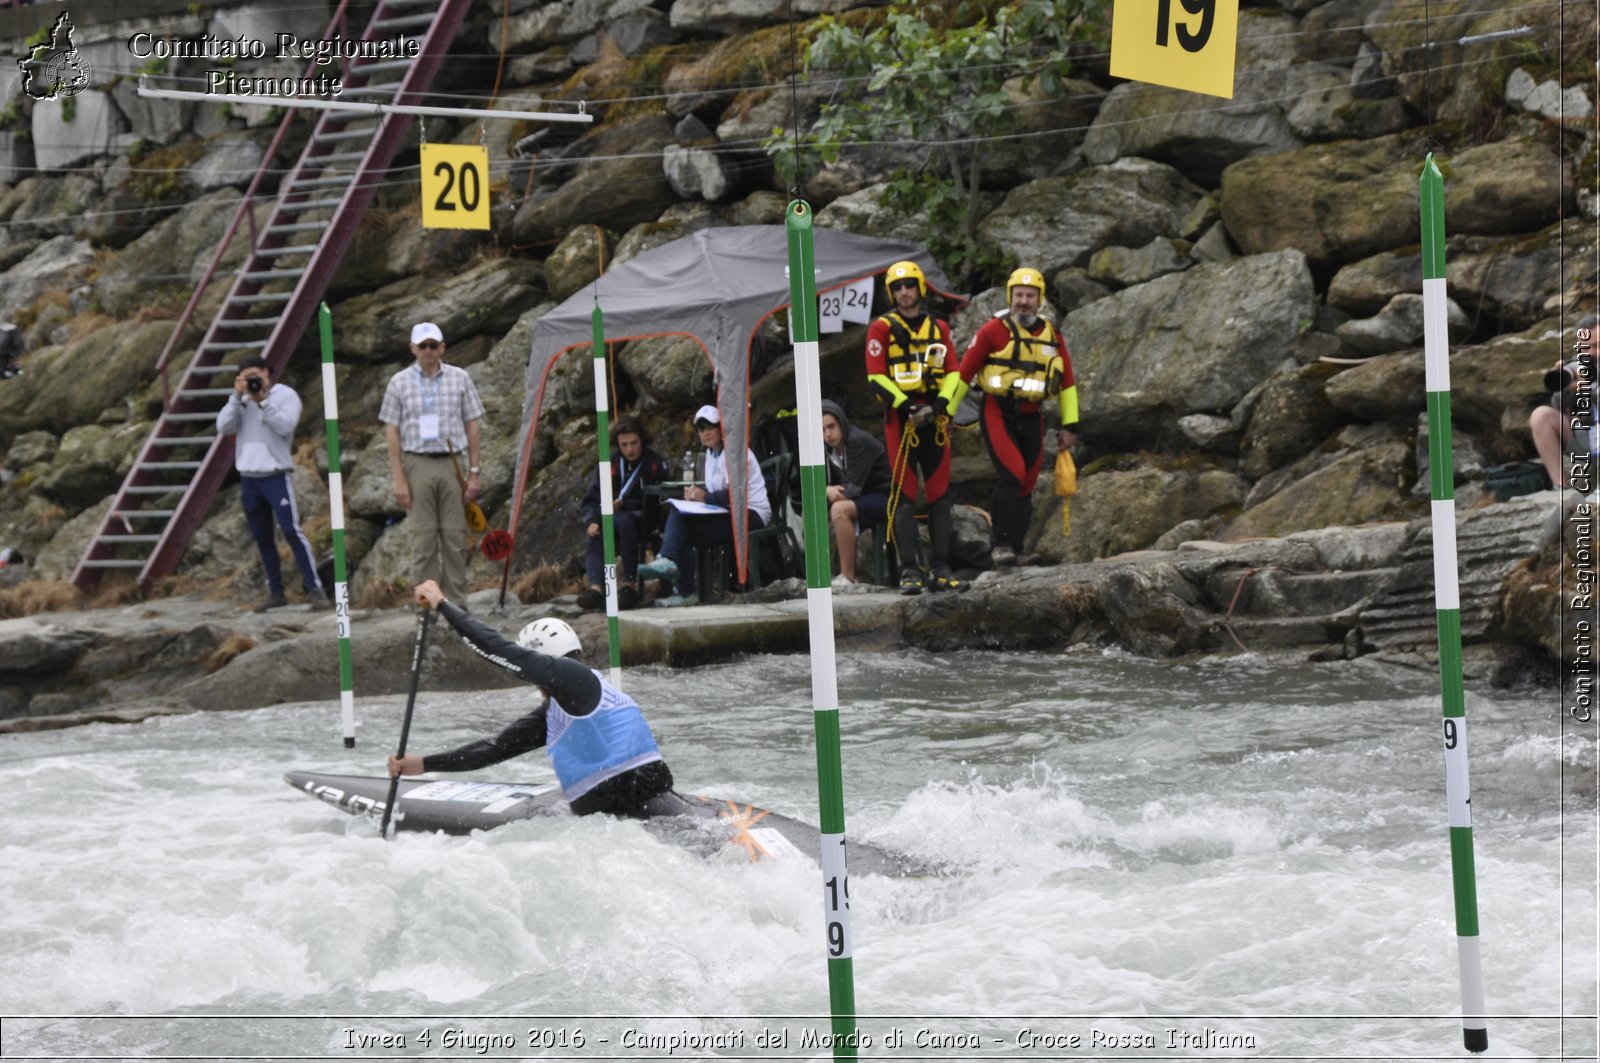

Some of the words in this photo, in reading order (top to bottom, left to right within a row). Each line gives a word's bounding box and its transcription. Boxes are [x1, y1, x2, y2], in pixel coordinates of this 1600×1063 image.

[433, 161, 480, 212] 20
[822, 298, 841, 317] 23
[846, 289, 868, 309] 24
[1443, 719, 1458, 750] 9
[828, 921, 845, 957] 9
